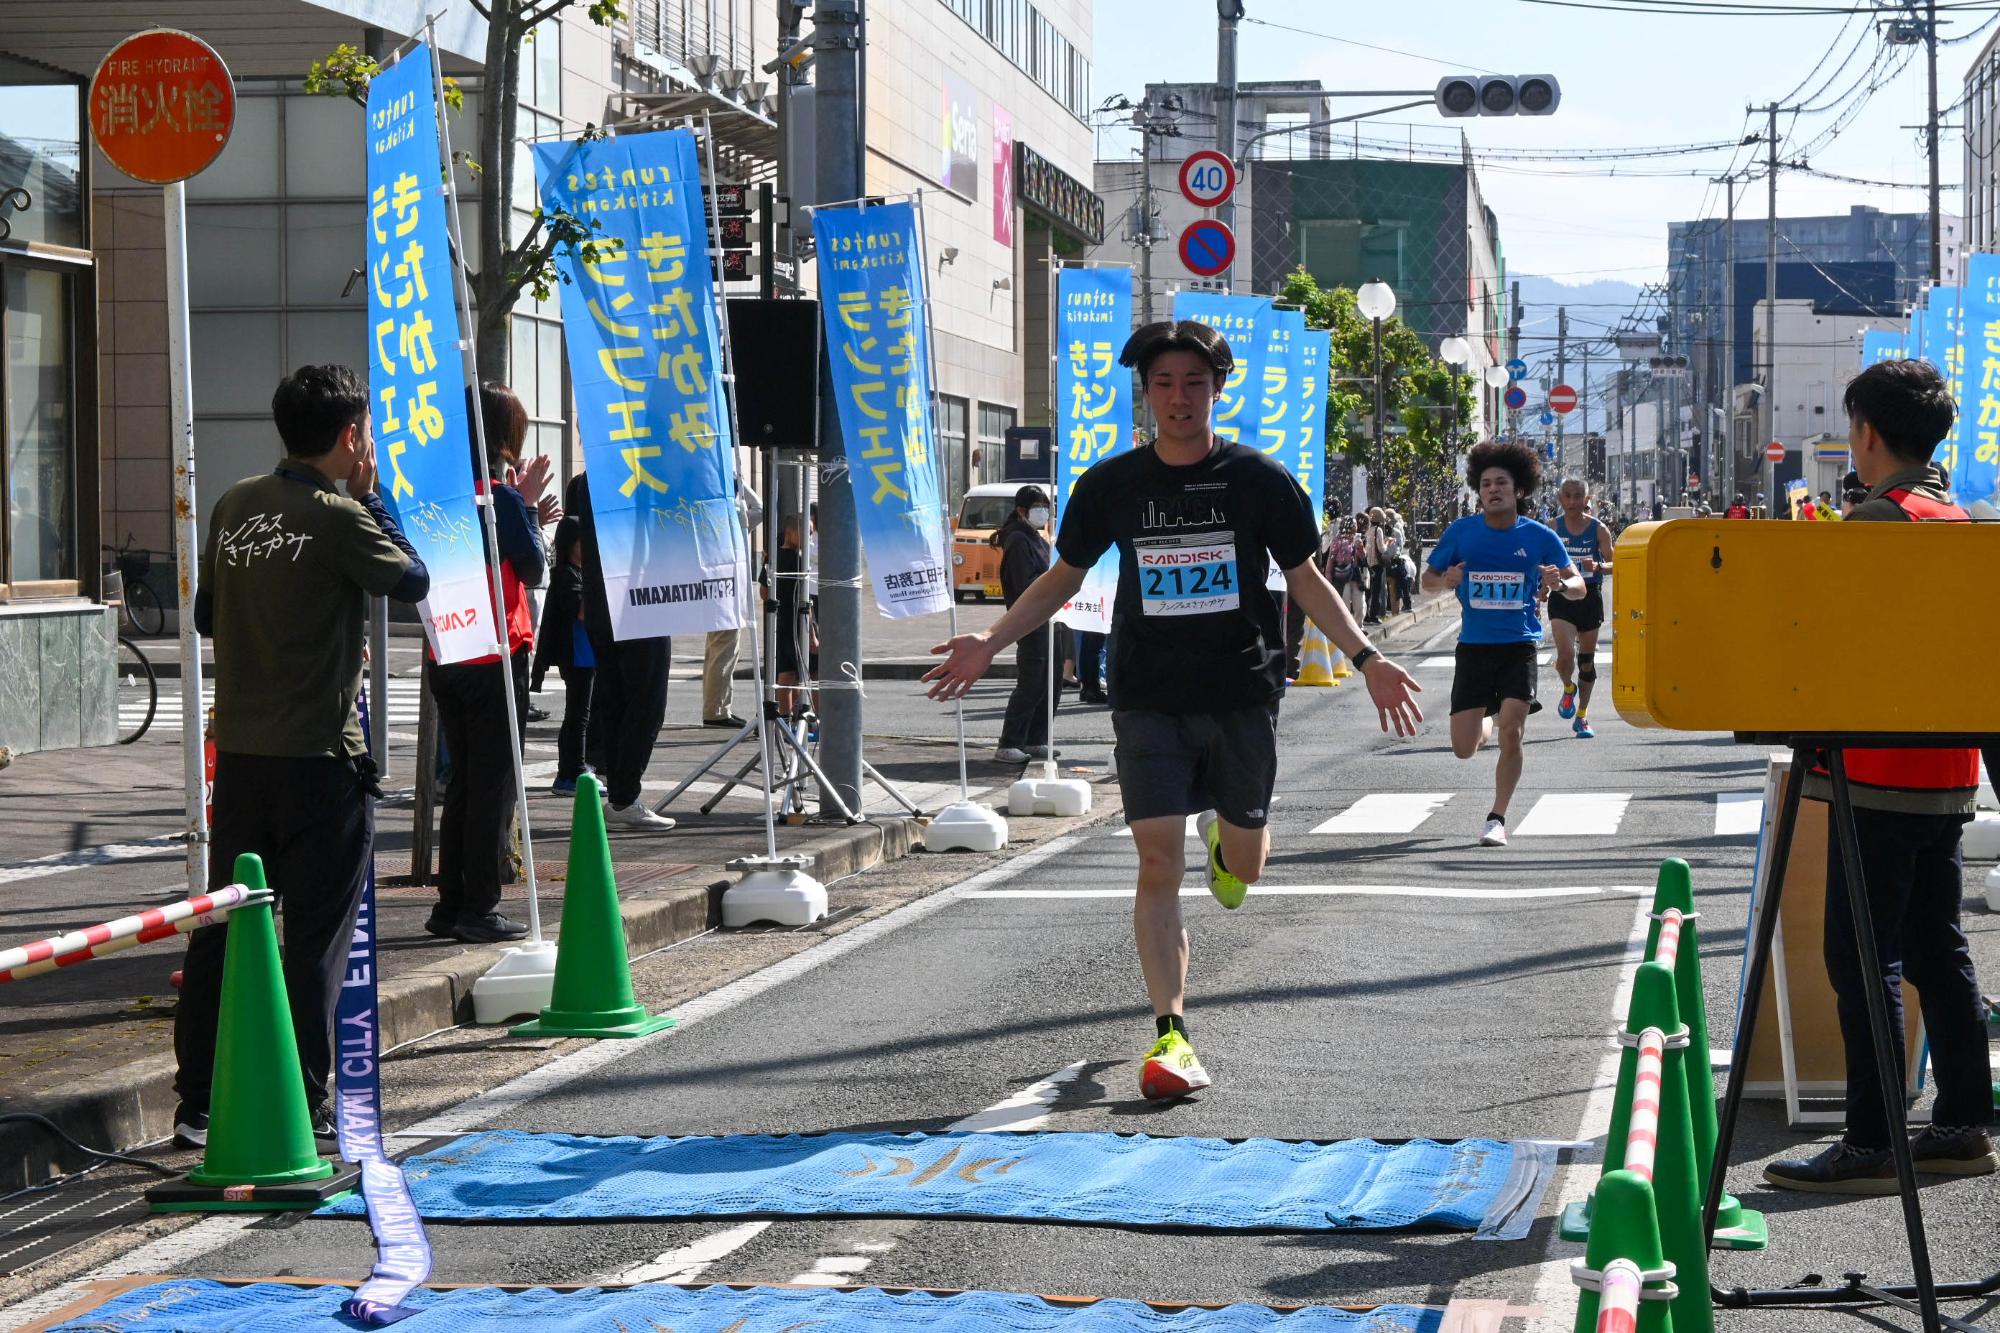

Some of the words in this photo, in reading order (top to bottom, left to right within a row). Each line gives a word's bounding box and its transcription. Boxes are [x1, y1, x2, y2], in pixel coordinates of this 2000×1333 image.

[109, 60, 140, 76] FIRE
[100, 80, 224, 136] 消火栓
[952, 101, 977, 162] Seria
[1192, 167, 1222, 191] 40
[1067, 289, 1115, 309] runfes
[1067, 310, 1113, 323] kitakami
[1191, 313, 1254, 330] runfes
[1143, 551, 1223, 565] SANDISK
[1146, 564, 1232, 595] 2124
[1472, 582, 1521, 598] 2117
